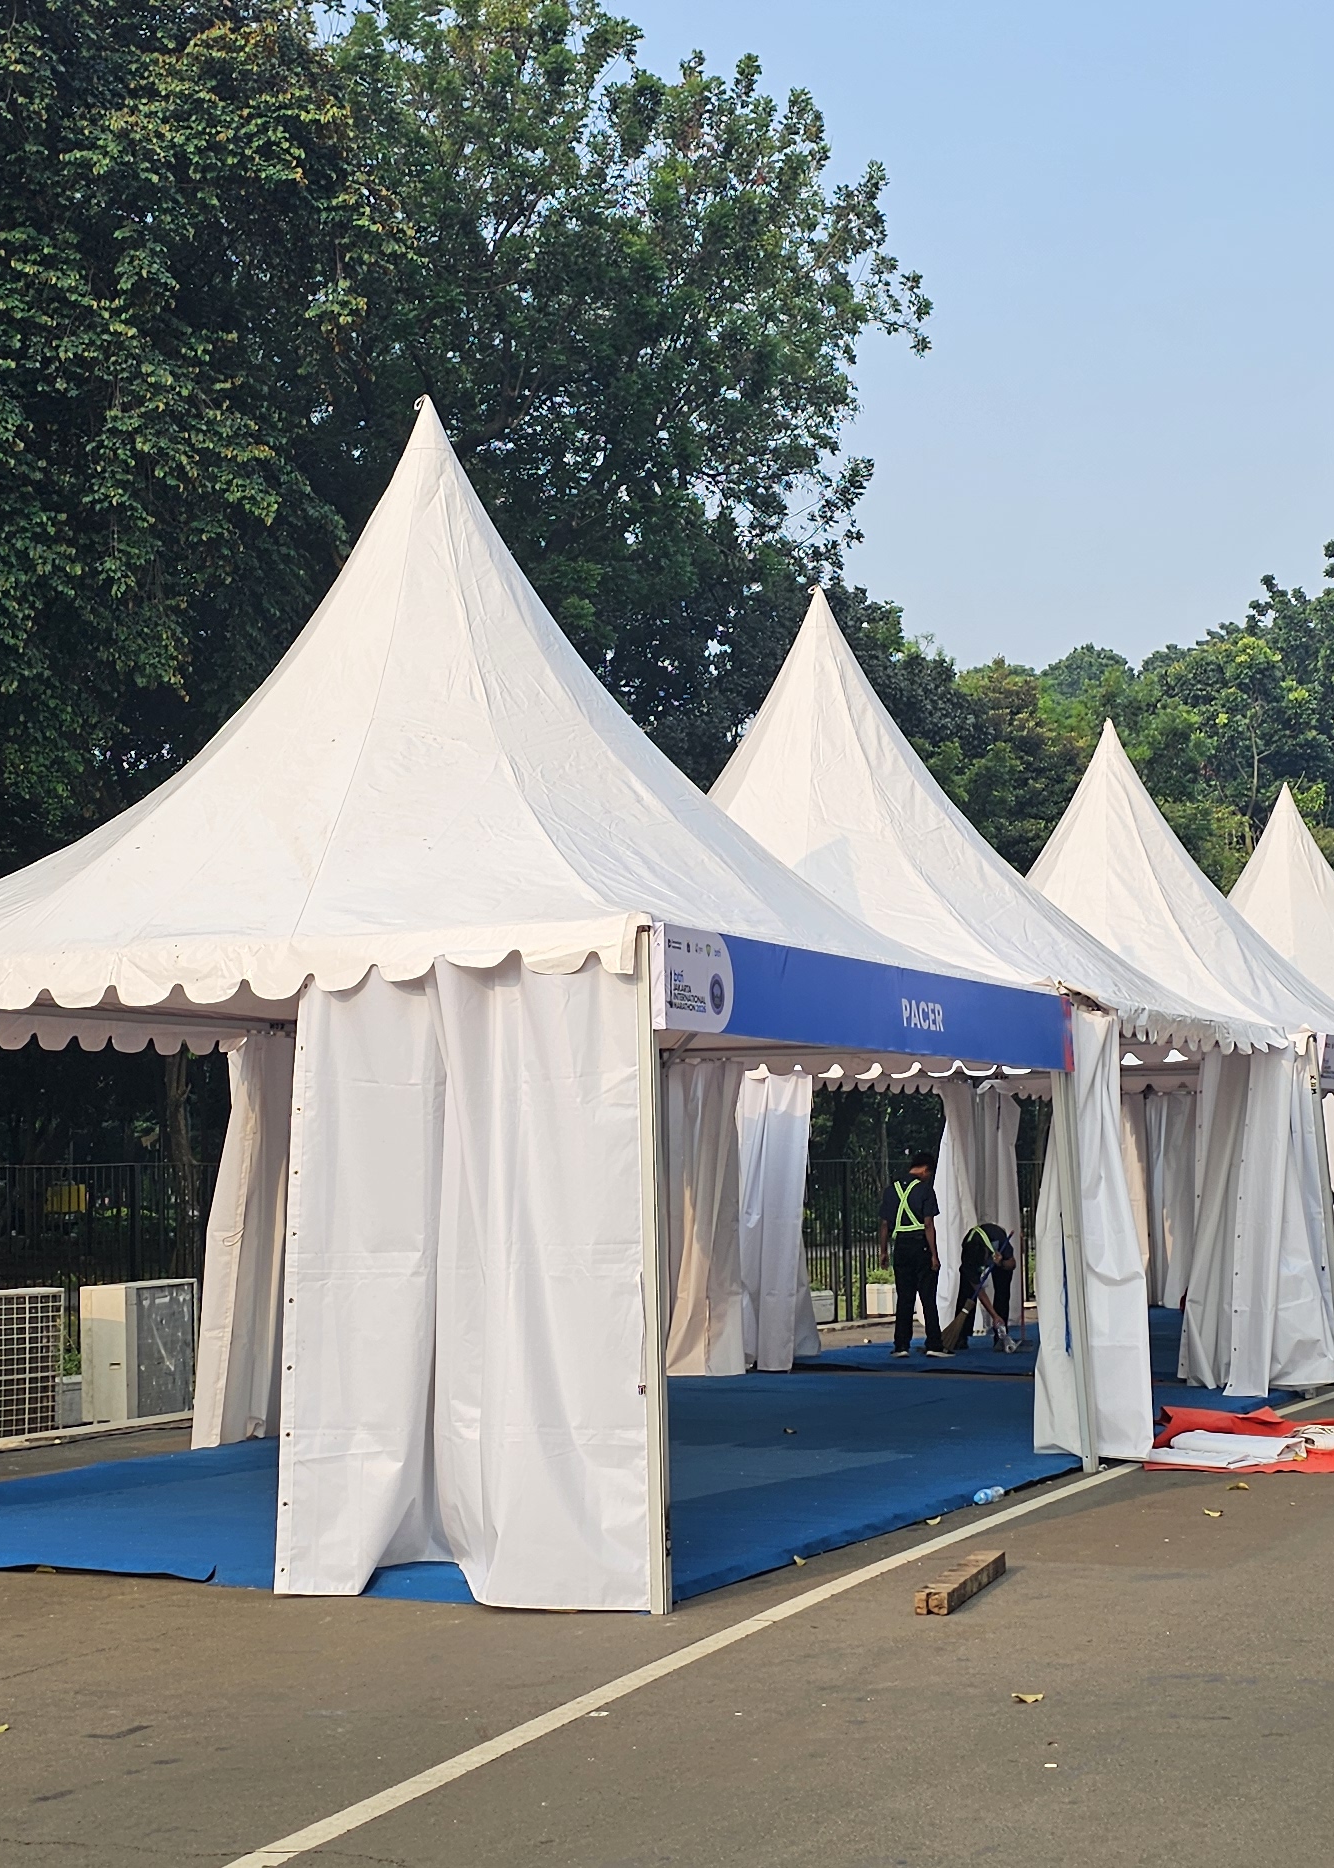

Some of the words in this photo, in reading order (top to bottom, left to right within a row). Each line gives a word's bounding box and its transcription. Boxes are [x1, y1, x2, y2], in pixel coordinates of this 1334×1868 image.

[673, 992, 706, 1005] INTERNATIONAL
[673, 1003, 696, 1011] MARATHON
[901, 998, 944, 1032] PACER
